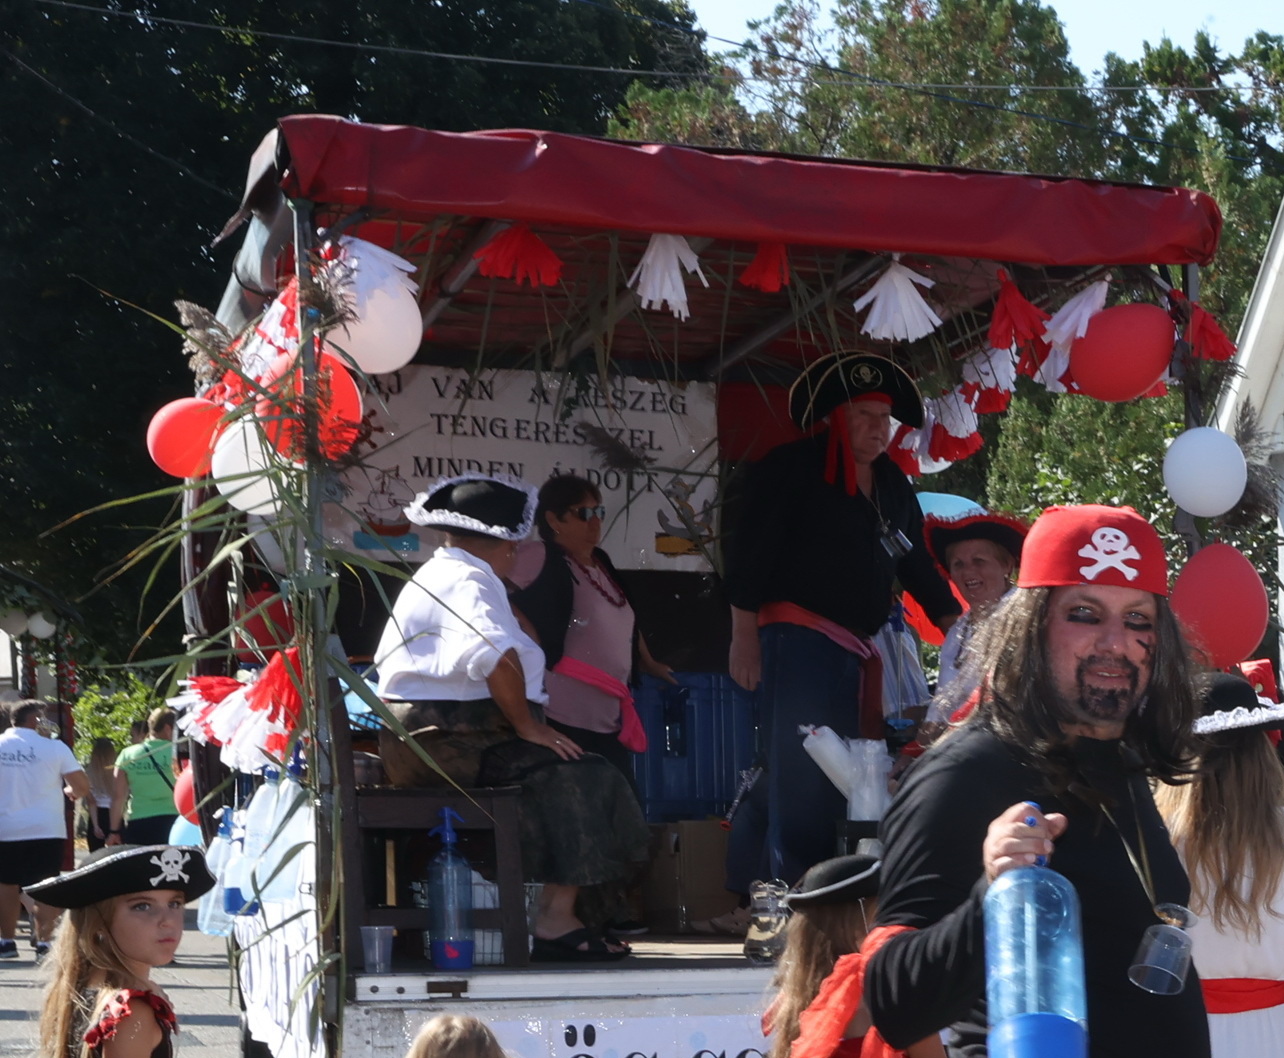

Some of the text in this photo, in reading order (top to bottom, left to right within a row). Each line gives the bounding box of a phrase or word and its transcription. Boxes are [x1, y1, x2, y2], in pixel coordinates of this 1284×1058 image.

[431, 376, 494, 401] VAN
[413, 455, 659, 493] MINDEN ÁDOTT
